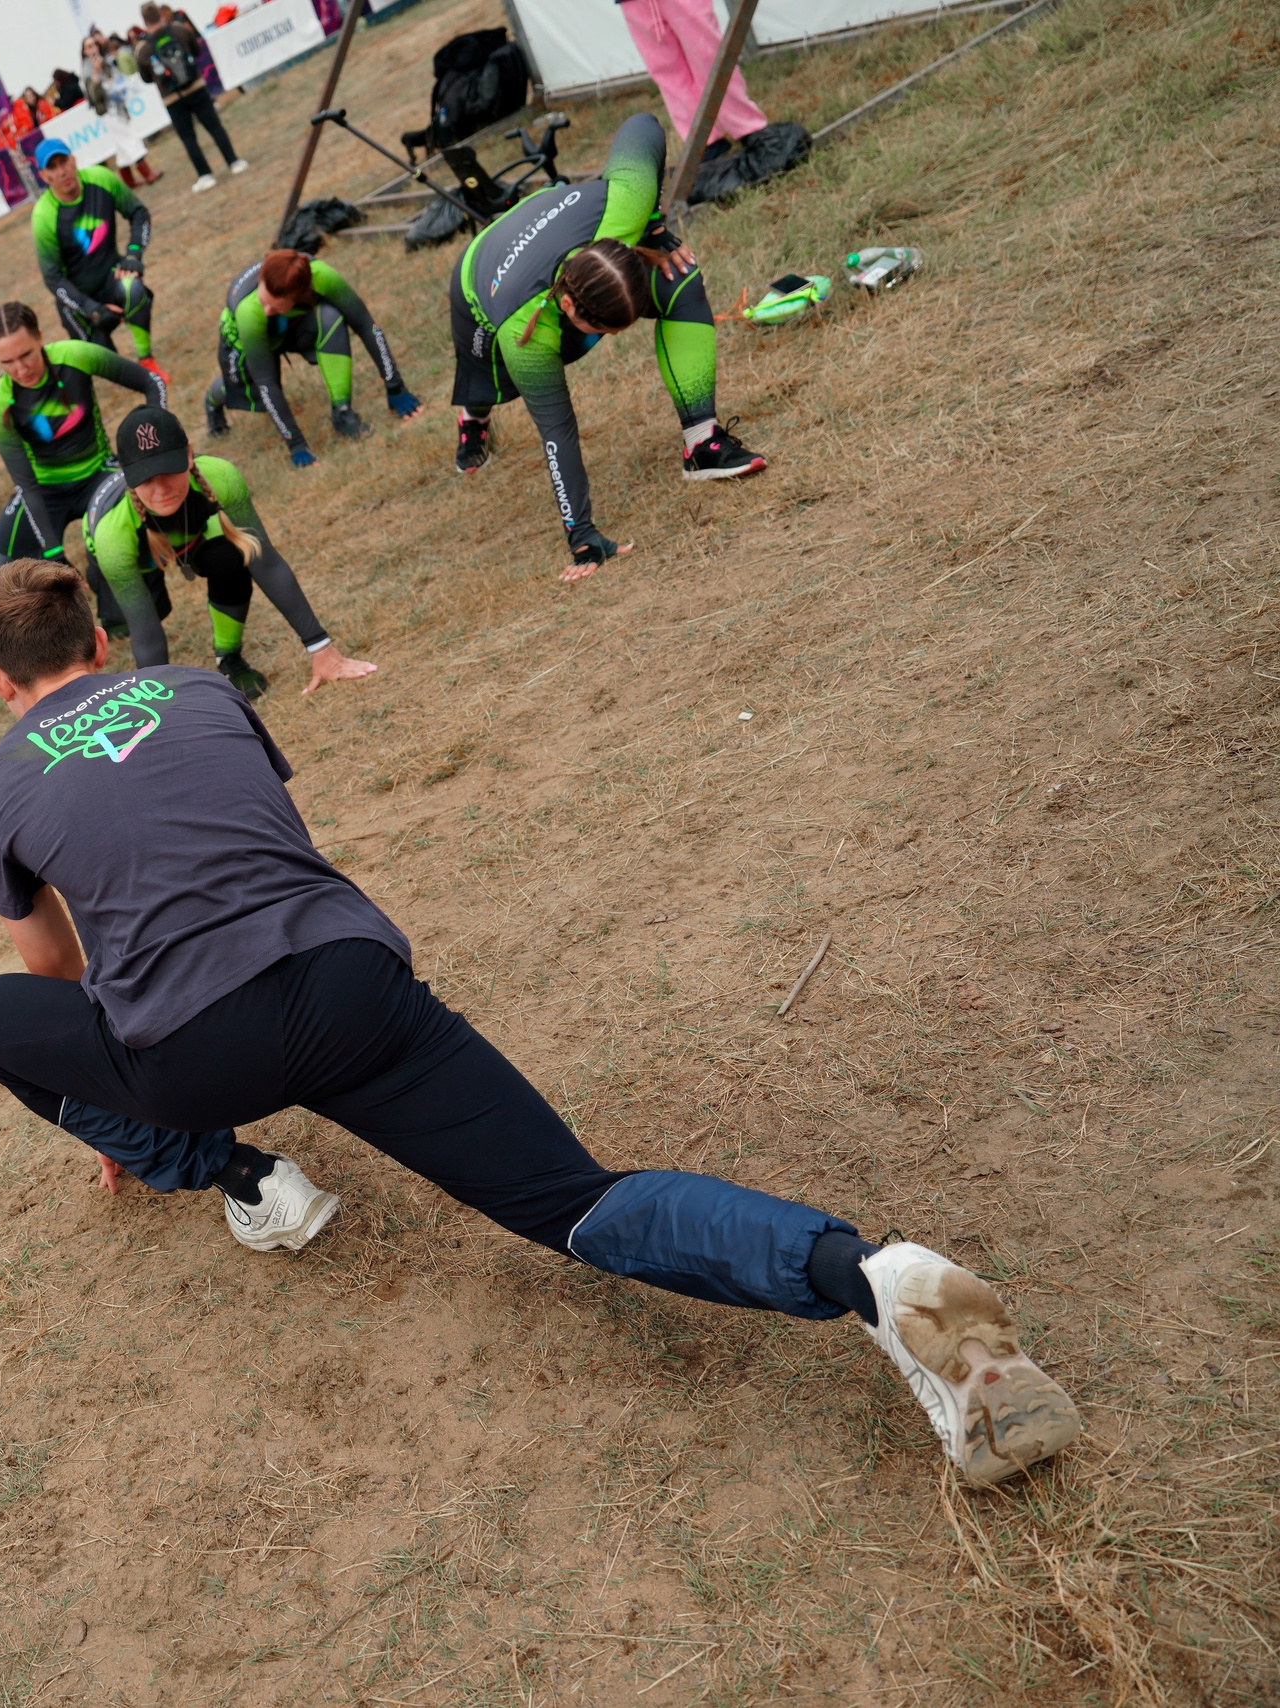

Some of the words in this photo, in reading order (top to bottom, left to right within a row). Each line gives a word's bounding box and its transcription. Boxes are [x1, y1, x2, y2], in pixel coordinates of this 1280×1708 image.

[67, 97, 146, 152] INVIO
[496, 190, 581, 281] Greenway
[546, 441, 574, 521] Greenway
[40, 677, 136, 728] Greenway
